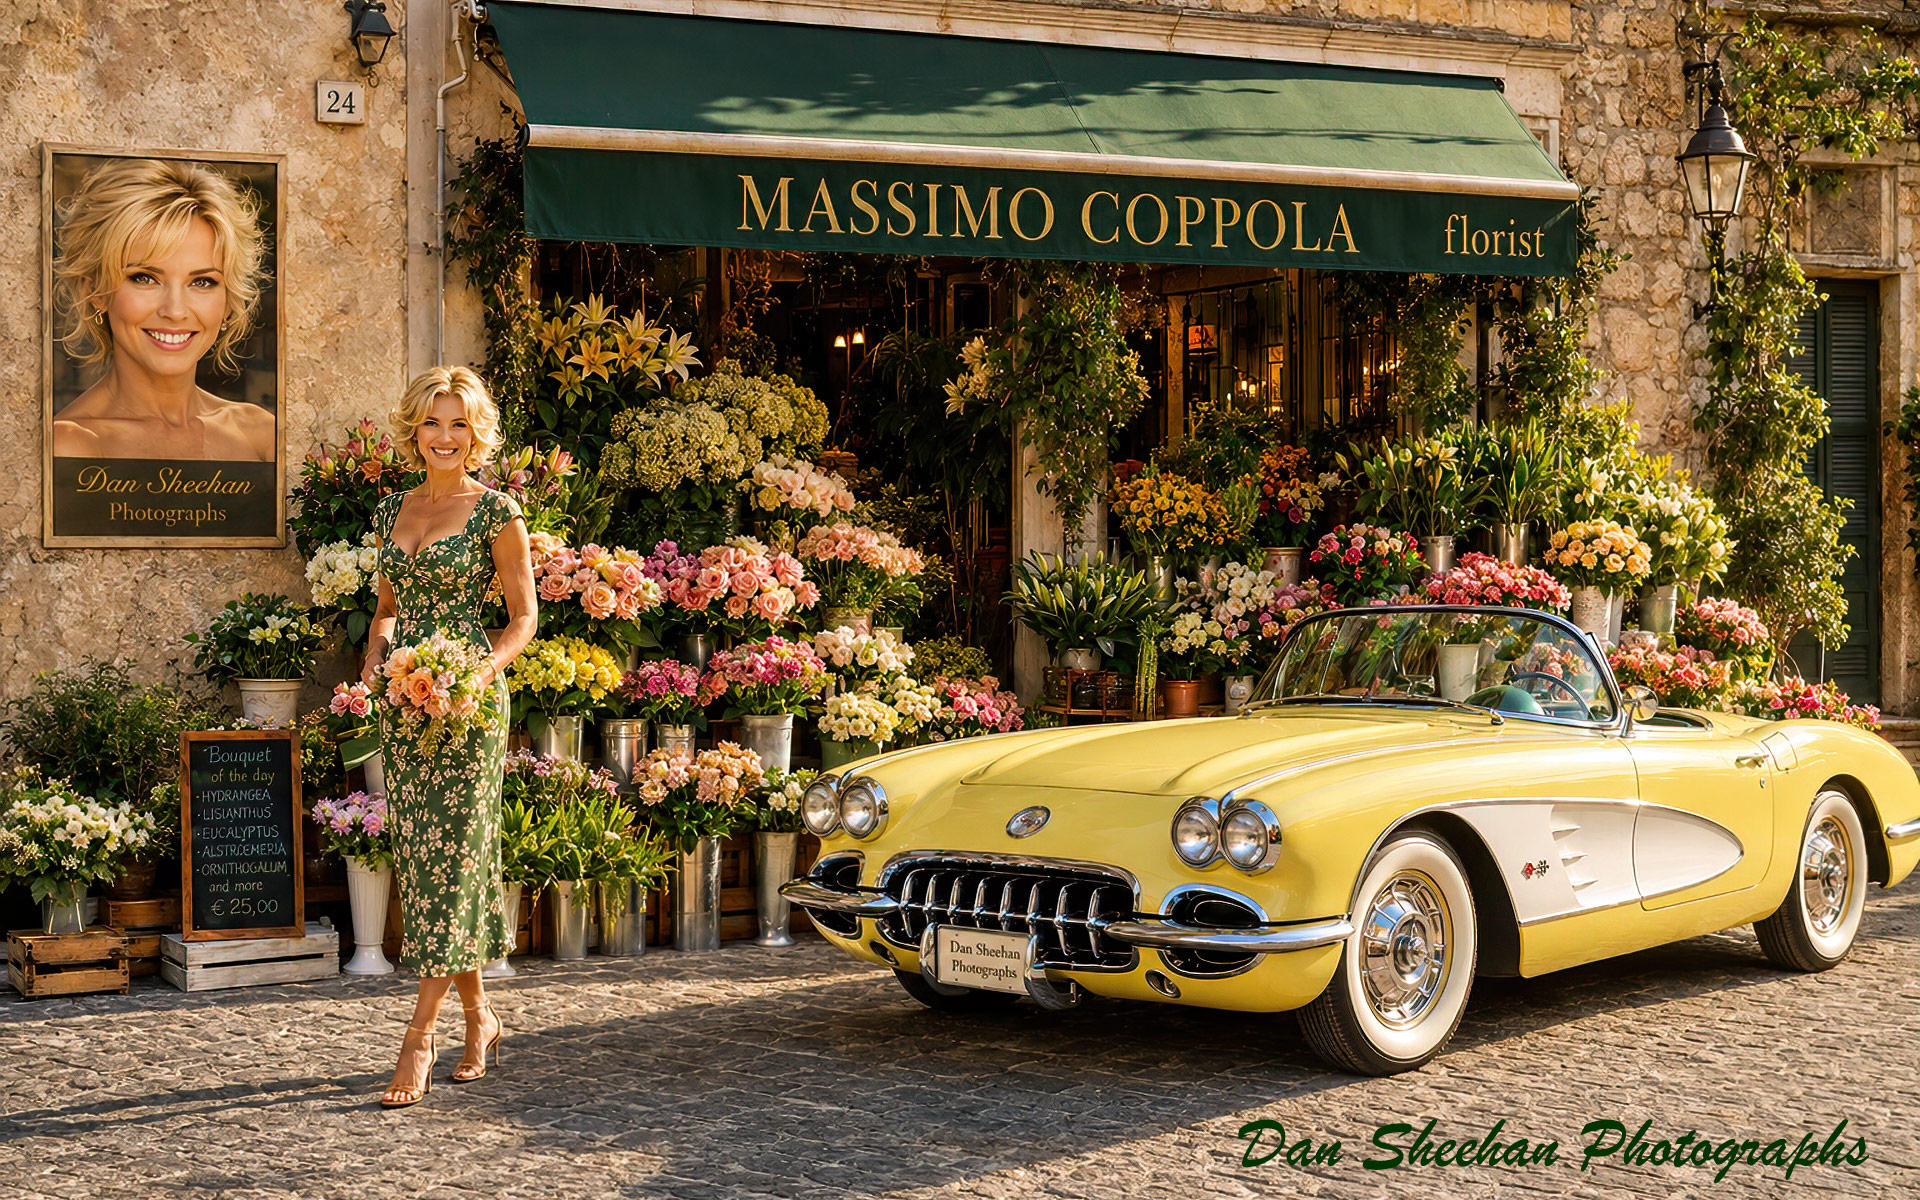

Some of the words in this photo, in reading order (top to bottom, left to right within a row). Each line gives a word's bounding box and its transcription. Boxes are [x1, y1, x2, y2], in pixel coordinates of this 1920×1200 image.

[327, 90, 355, 114] 24
[737, 174, 1055, 241] MASSIMO
[1081, 191, 1360, 253] COPPOLA
[1444, 213, 1545, 258] florist
[76, 465, 142, 493] Dan
[147, 466, 256, 495] Sheehan
[109, 502, 227, 527] Photographs
[209, 745, 272, 767] Bouquet
[211, 768, 224, 783] of
[229, 767, 248, 782] the
[252, 767, 275, 787] day
[202, 788, 271, 803] HYDRANGEA
[203, 806, 272, 820] LISIANTHUS
[202, 825, 280, 840] EUCALYPTUS
[202, 860, 287, 876] ORNITHOGALUM
[209, 879, 229, 893] and
[234, 880, 264, 893] more
[230, 897, 279, 917] 25,00
[950, 940, 972, 955] Dan
[976, 943, 1020, 960] Sheehan
[952, 959, 1018, 981] Photographs
